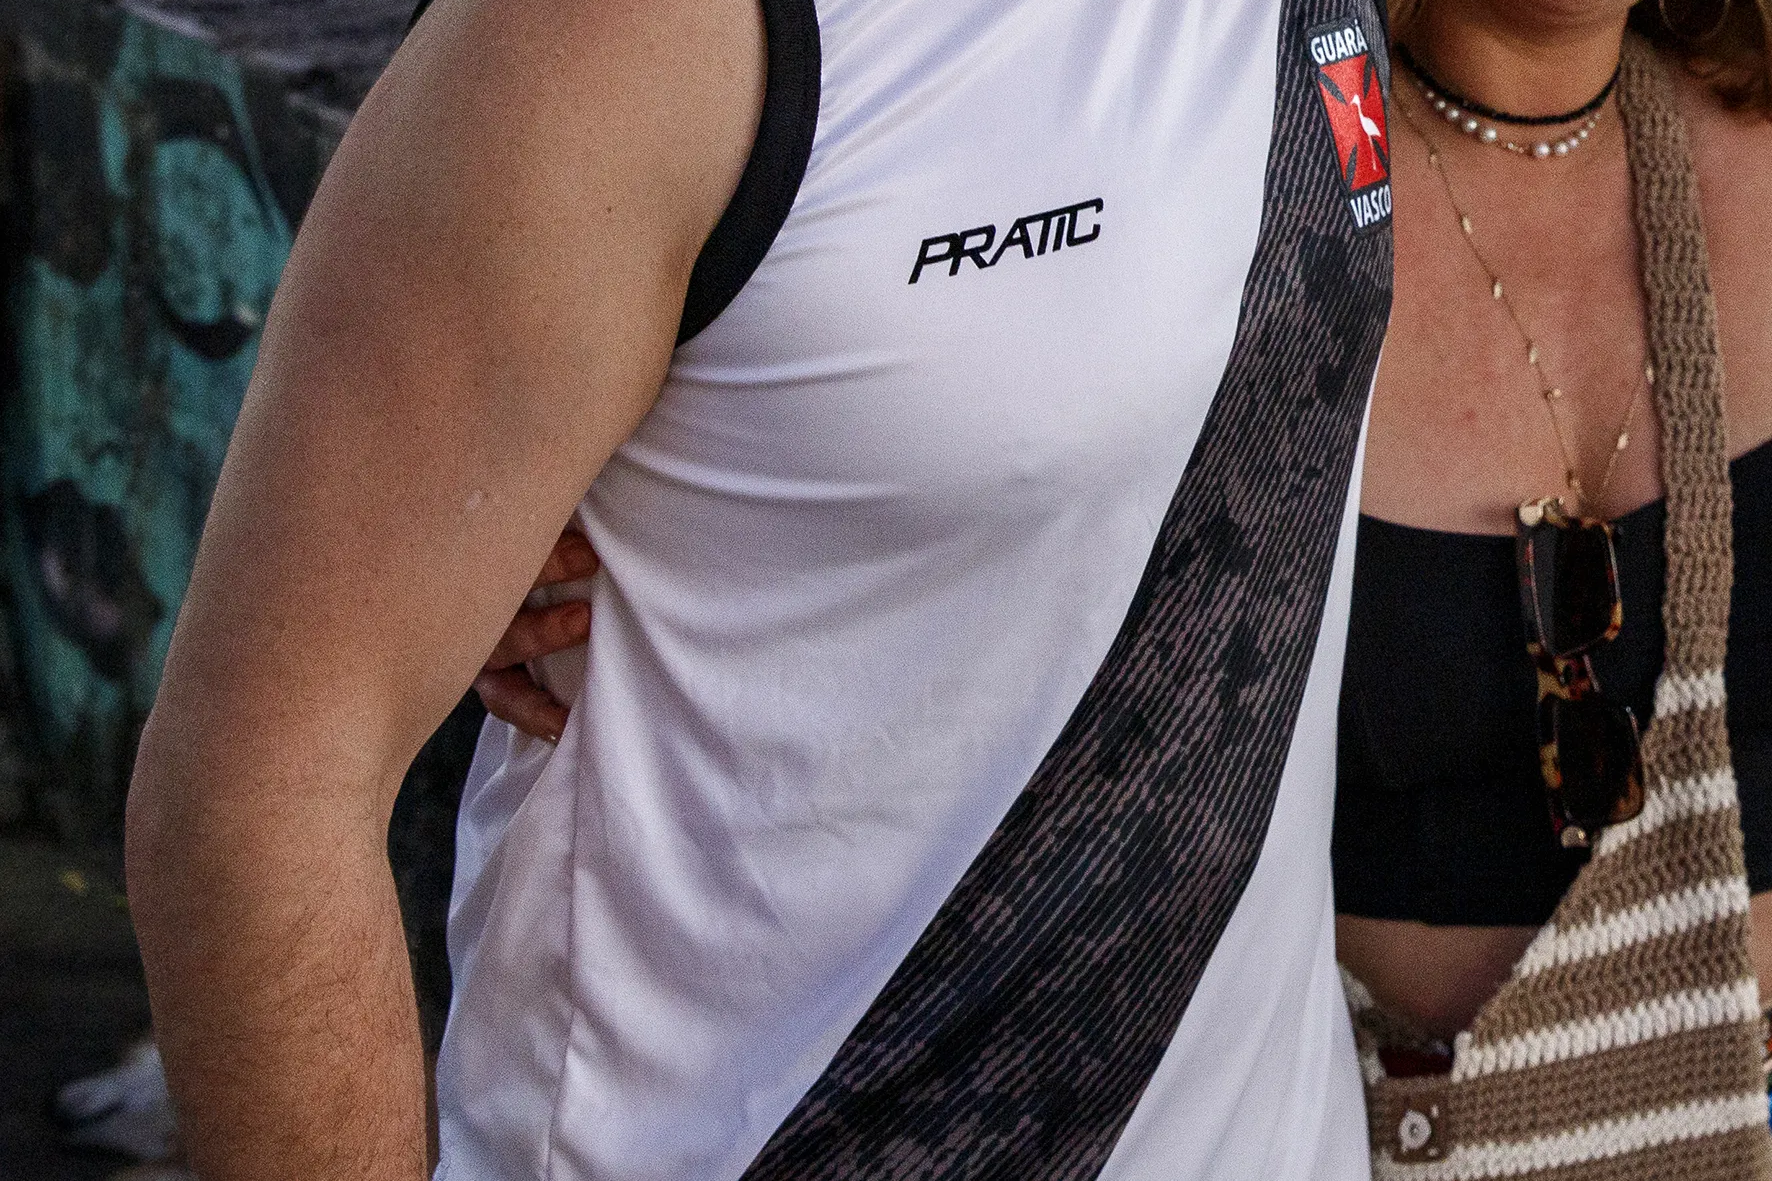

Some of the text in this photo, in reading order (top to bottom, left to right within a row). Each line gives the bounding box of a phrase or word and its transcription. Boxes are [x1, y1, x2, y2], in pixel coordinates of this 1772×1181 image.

[1310, 19, 1368, 65] GUARÁ
[1350, 184, 1392, 228] VASCO
[908, 197, 1104, 285] PRATIC
